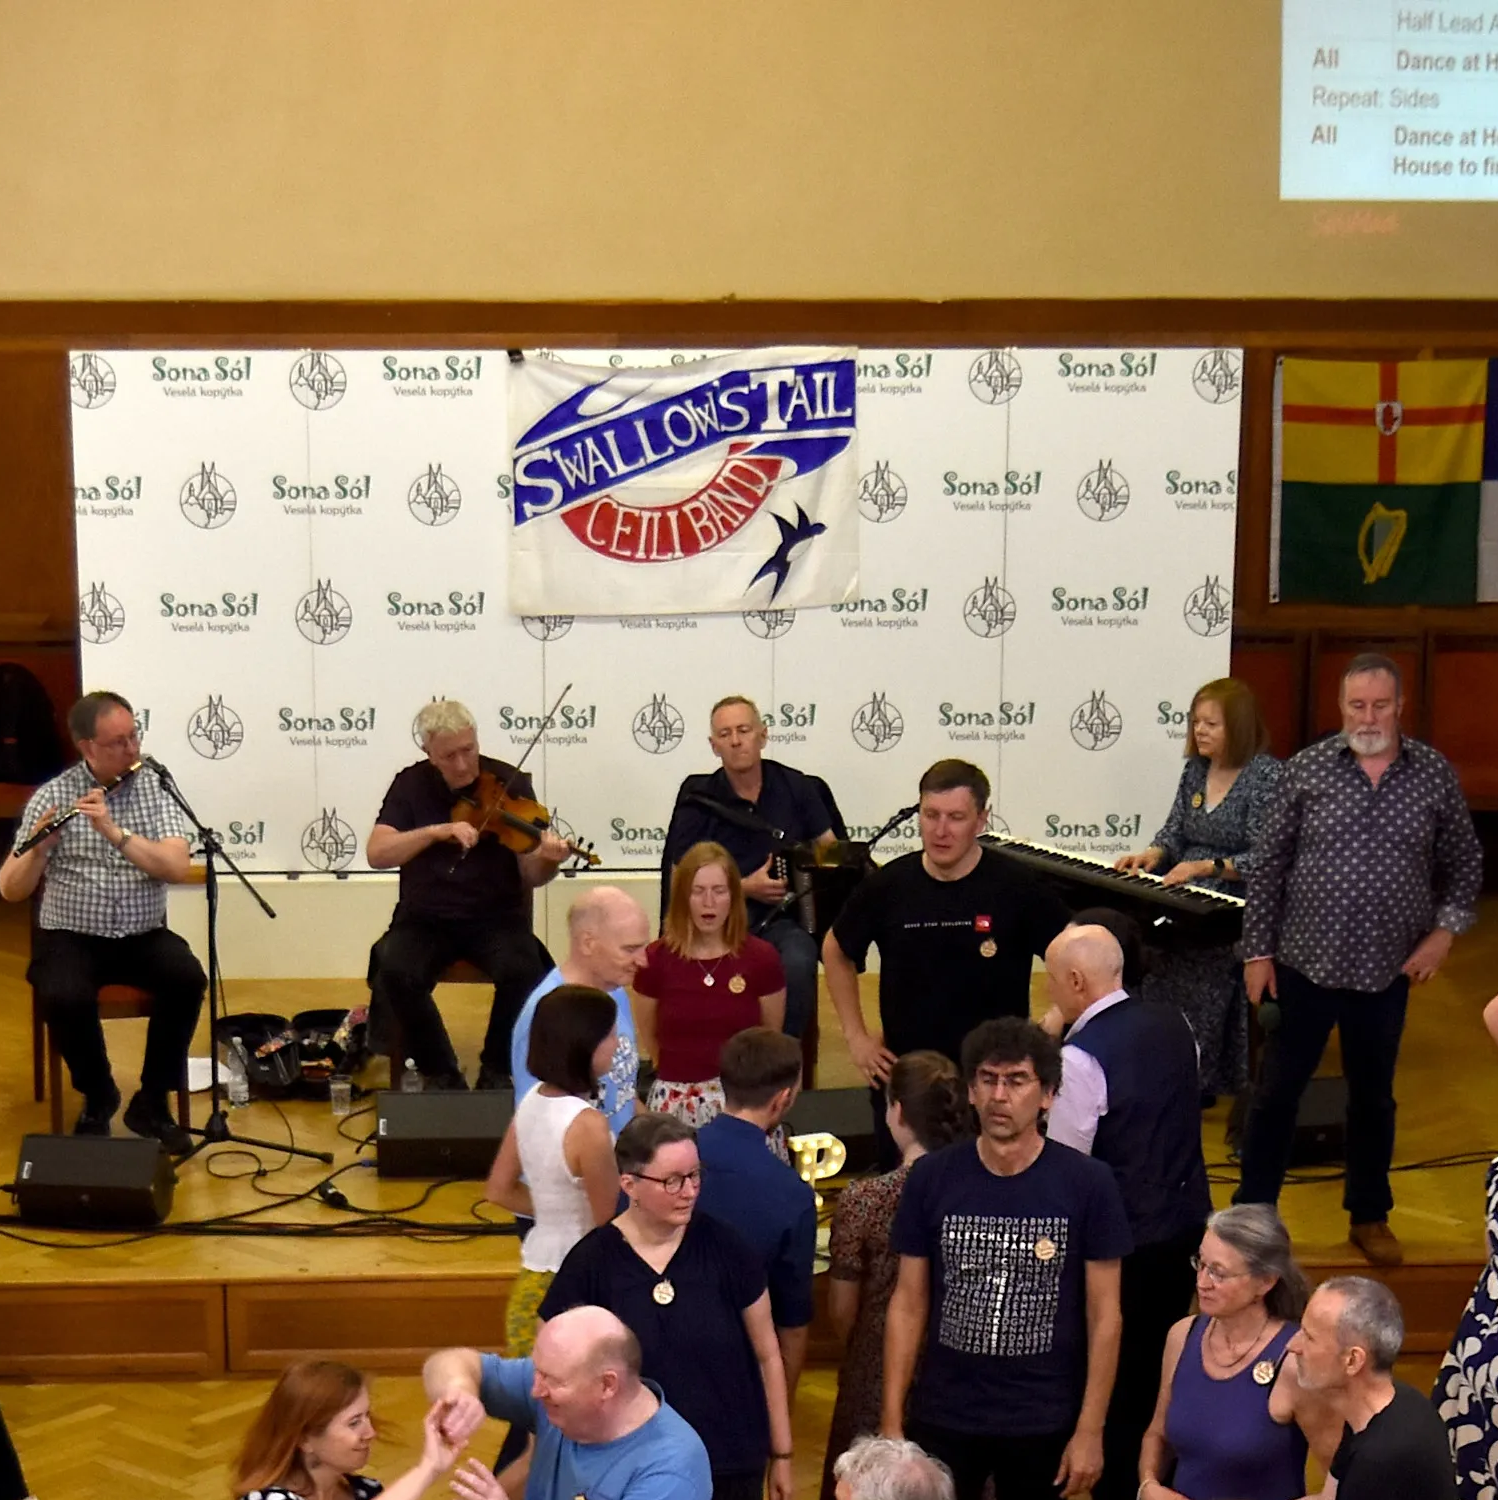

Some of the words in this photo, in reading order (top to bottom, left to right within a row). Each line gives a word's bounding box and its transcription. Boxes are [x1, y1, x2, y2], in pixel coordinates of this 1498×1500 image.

[1397, 9, 1434, 32] Half
[1438, 12, 1484, 33] Lead
[1313, 48, 1339, 68] All
[1397, 50, 1456, 71] Dance
[1462, 54, 1480, 71] at
[1313, 85, 1382, 112] Repeat:
[1390, 87, 1439, 108] Sides
[1311, 125, 1337, 144] All
[1394, 125, 1454, 146] Dance
[1459, 129, 1477, 146] at
[1393, 156, 1453, 176] House
[1459, 158, 1477, 175] to
[152, 357, 210, 381] Sona
[215, 357, 251, 381] Sól
[383, 356, 440, 381] Sona
[446, 356, 481, 380] Sól
[857, 364, 890, 377] na
[895, 353, 932, 378] Sól
[1058, 353, 1115, 377] Sona
[1120, 352, 1157, 377] Sól
[163, 386, 196, 397] Veselá
[199, 386, 243, 399] kopýtka
[393, 386, 426, 396] Veselá
[430, 385, 473, 398] kopýtka
[751, 369, 852, 430] TAIL
[880, 384, 922, 396] kopýtka
[1068, 382, 1101, 393] Veselá
[1104, 382, 1146, 396] kopýtka
[74, 486, 101, 501] na
[106, 475, 142, 501] Sól
[273, 475, 330, 500] Sona
[335, 475, 370, 499] Sól
[943, 471, 999, 496] Sona
[1004, 471, 1041, 495] Sól
[1166, 470, 1221, 495] Sona
[283, 502, 316, 516] Veselá
[320, 504, 362, 517] kopýtka
[587, 494, 686, 560] CEILI
[682, 456, 780, 550] BAND
[953, 500, 985, 511] Veselá
[989, 500, 1031, 513] kopýtka
[1175, 500, 1207, 510] Veselá
[160, 593, 217, 617] Sona
[222, 593, 258, 617] Sól
[387, 592, 444, 616] Sona
[449, 592, 484, 615] Sól
[892, 588, 928, 612] Sól
[1052, 587, 1107, 611] Sona
[1113, 587, 1149, 611] Sól
[171, 622, 204, 632] Veselá
[207, 622, 250, 634] kopýtka
[397, 620, 430, 631] Veselá
[433, 620, 476, 633] kopýtka
[656, 618, 698, 631] kopýtka
[841, 617, 873, 627] Veselá
[877, 617, 918, 629] kopýtka
[1061, 616, 1093, 626] Veselá
[1097, 616, 1138, 628] kopýtka
[279, 708, 335, 731] Sona
[340, 708, 375, 731] Sól
[499, 706, 557, 730] Sona
[560, 706, 596, 730] Sól
[781, 703, 816, 727] Sól
[939, 703, 994, 726] Sona
[999, 702, 1035, 725] Sól
[289, 735, 322, 746] Veselá
[325, 736, 367, 748] kopýtka
[546, 734, 587, 747] kopýtka
[948, 731, 980, 740] Veselá
[984, 731, 1025, 743] kopýtka
[229, 821, 265, 845] Sól
[611, 817, 666, 841] Sona
[1046, 815, 1100, 837] Sona
[1106, 814, 1141, 837] Sól
[1055, 842, 1086, 851] Veselá
[1090, 842, 1131, 854] kopýtka
[949, 1232, 1018, 1242] BLETCHLEY
[1003, 1241, 1034, 1250] PARK
